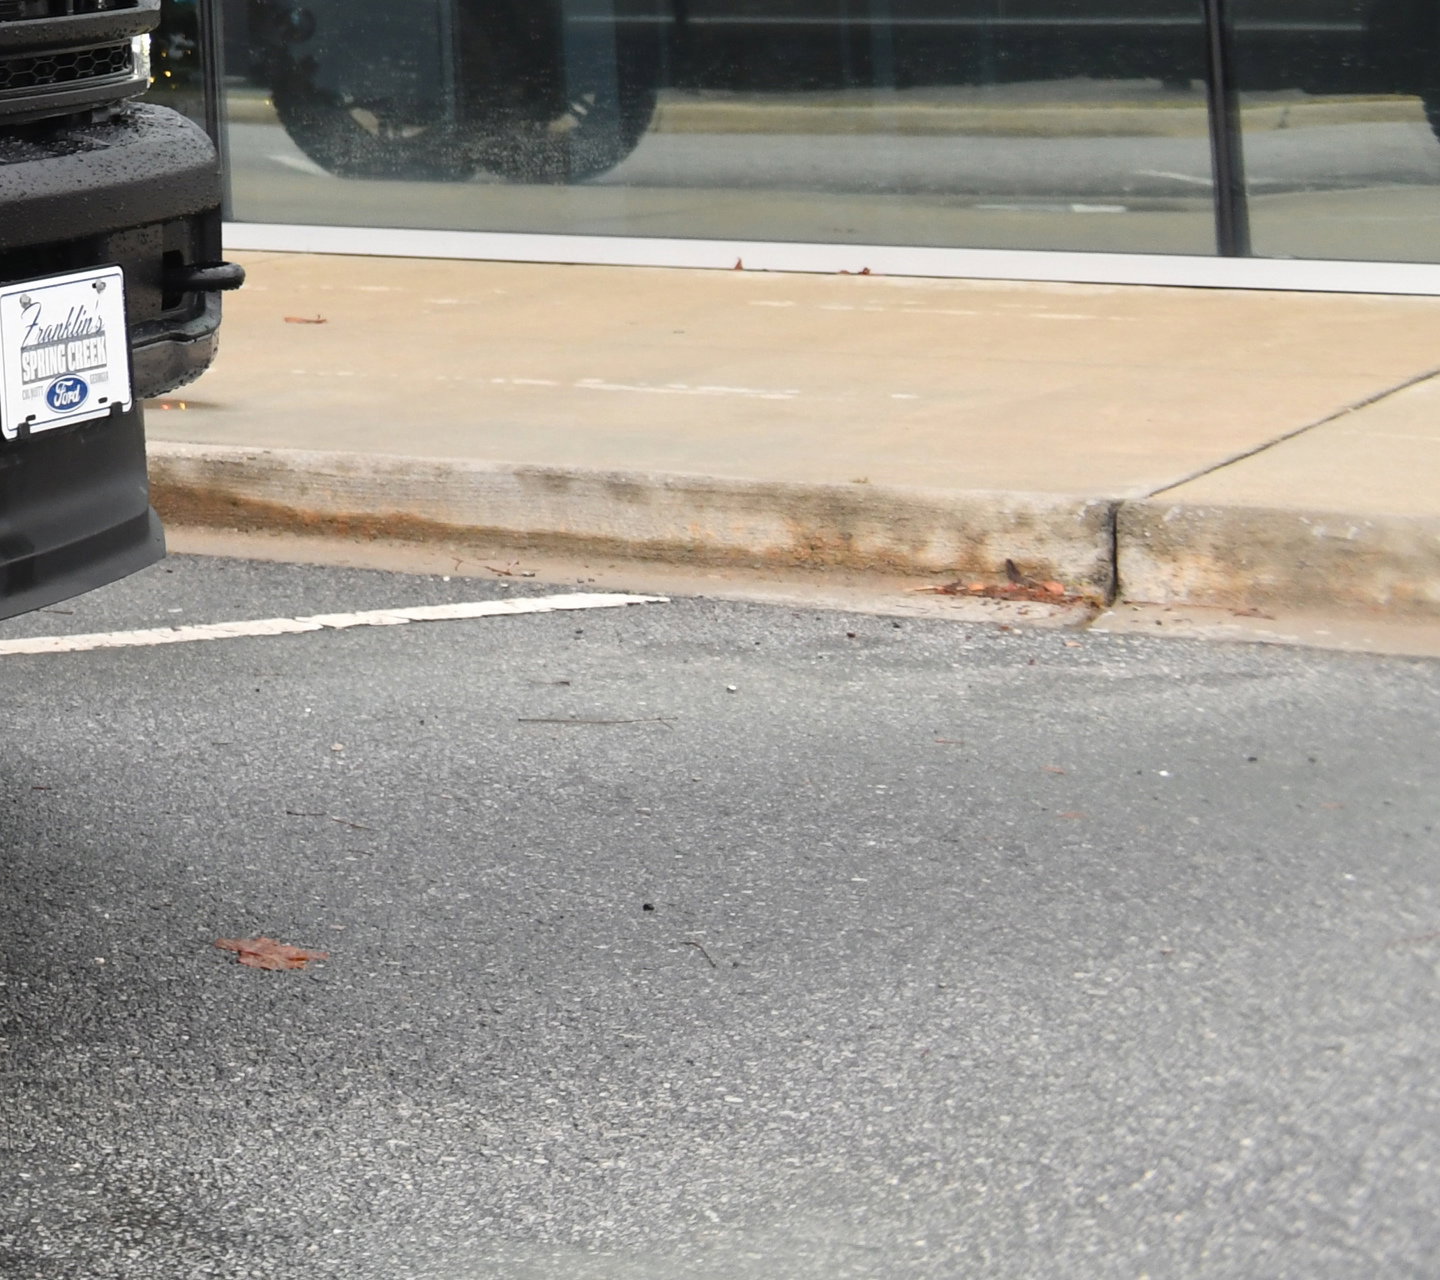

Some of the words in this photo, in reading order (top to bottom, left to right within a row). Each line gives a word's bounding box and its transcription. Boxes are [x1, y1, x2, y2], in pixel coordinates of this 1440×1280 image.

[21, 299, 104, 348] Franklin's
[22, 343, 67, 383] SPRING
[67, 336, 107, 373] CREEK
[53, 380, 81, 408] Ford
